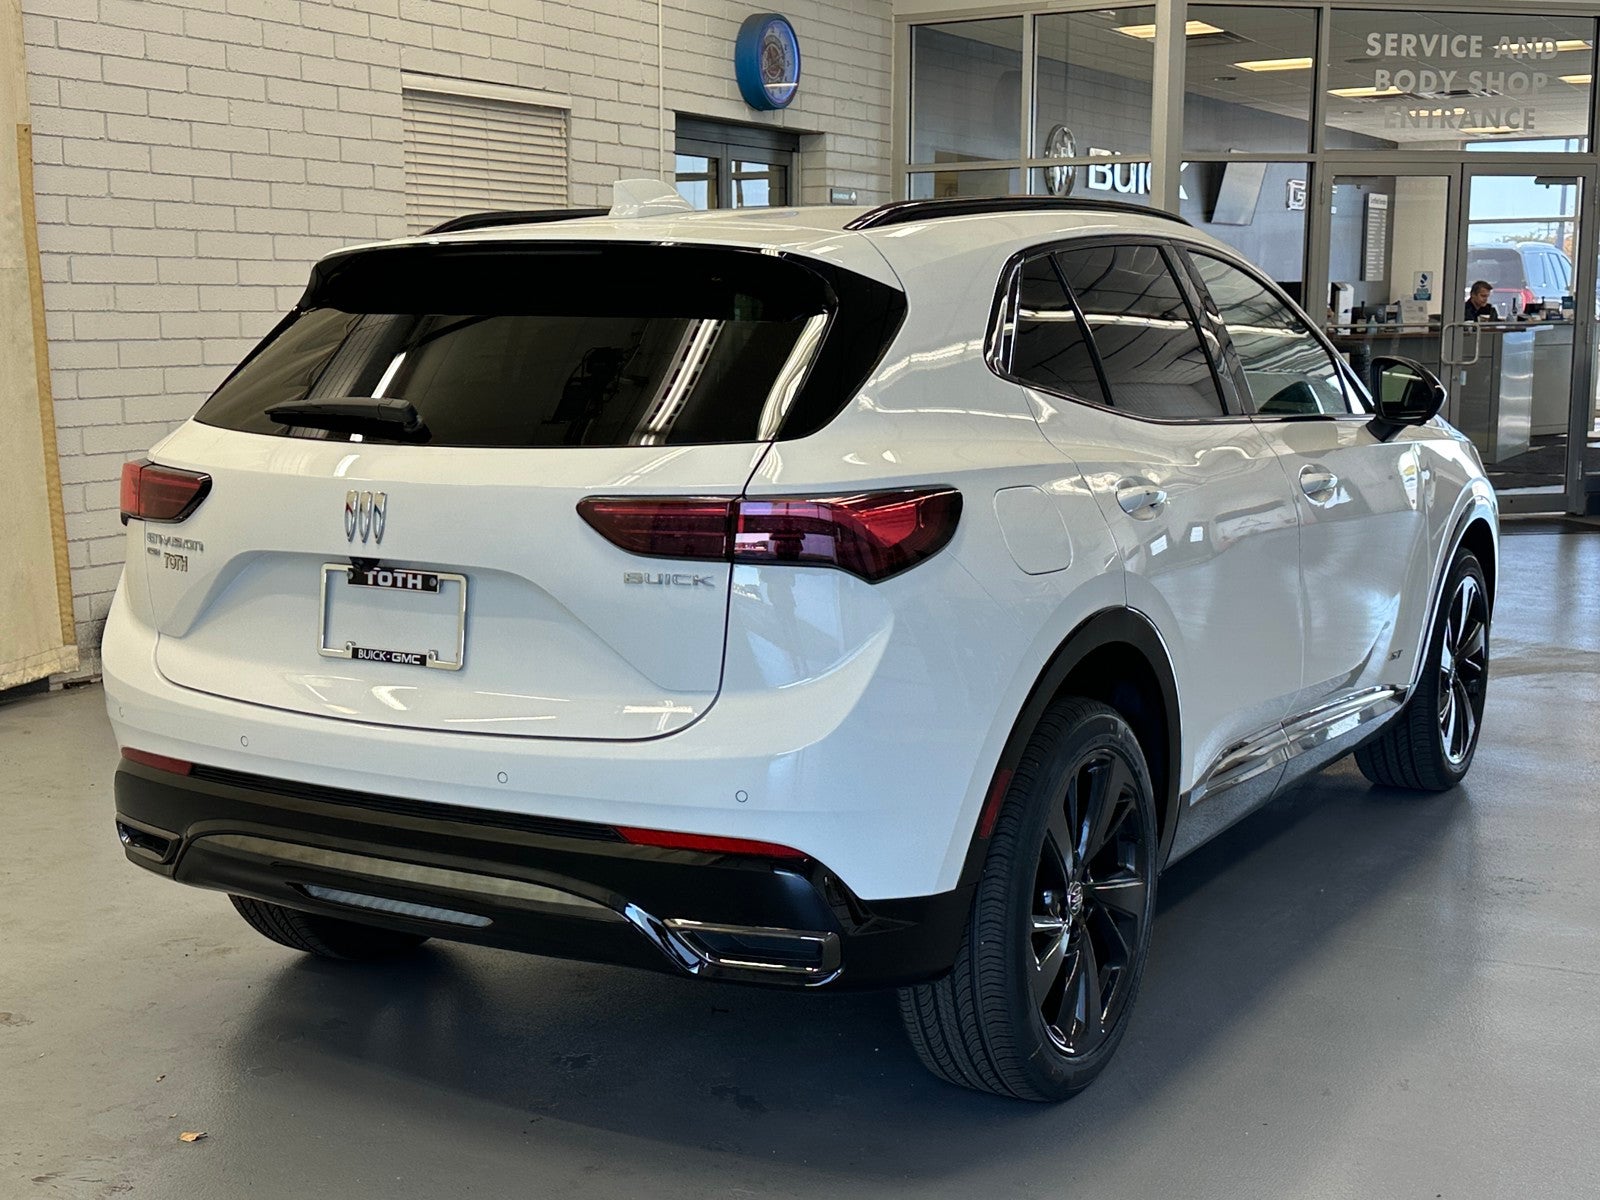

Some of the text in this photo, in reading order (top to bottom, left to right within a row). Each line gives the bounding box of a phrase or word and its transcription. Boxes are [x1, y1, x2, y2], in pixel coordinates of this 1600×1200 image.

[1365, 32, 1558, 60] SERVICE AND
[1374, 69, 1549, 96] BODY SHOP
[1384, 105, 1537, 130] ENTRANCE
[164, 552, 188, 572] TOTH
[364, 570, 423, 590] TOTH
[623, 572, 715, 587] BUICK
